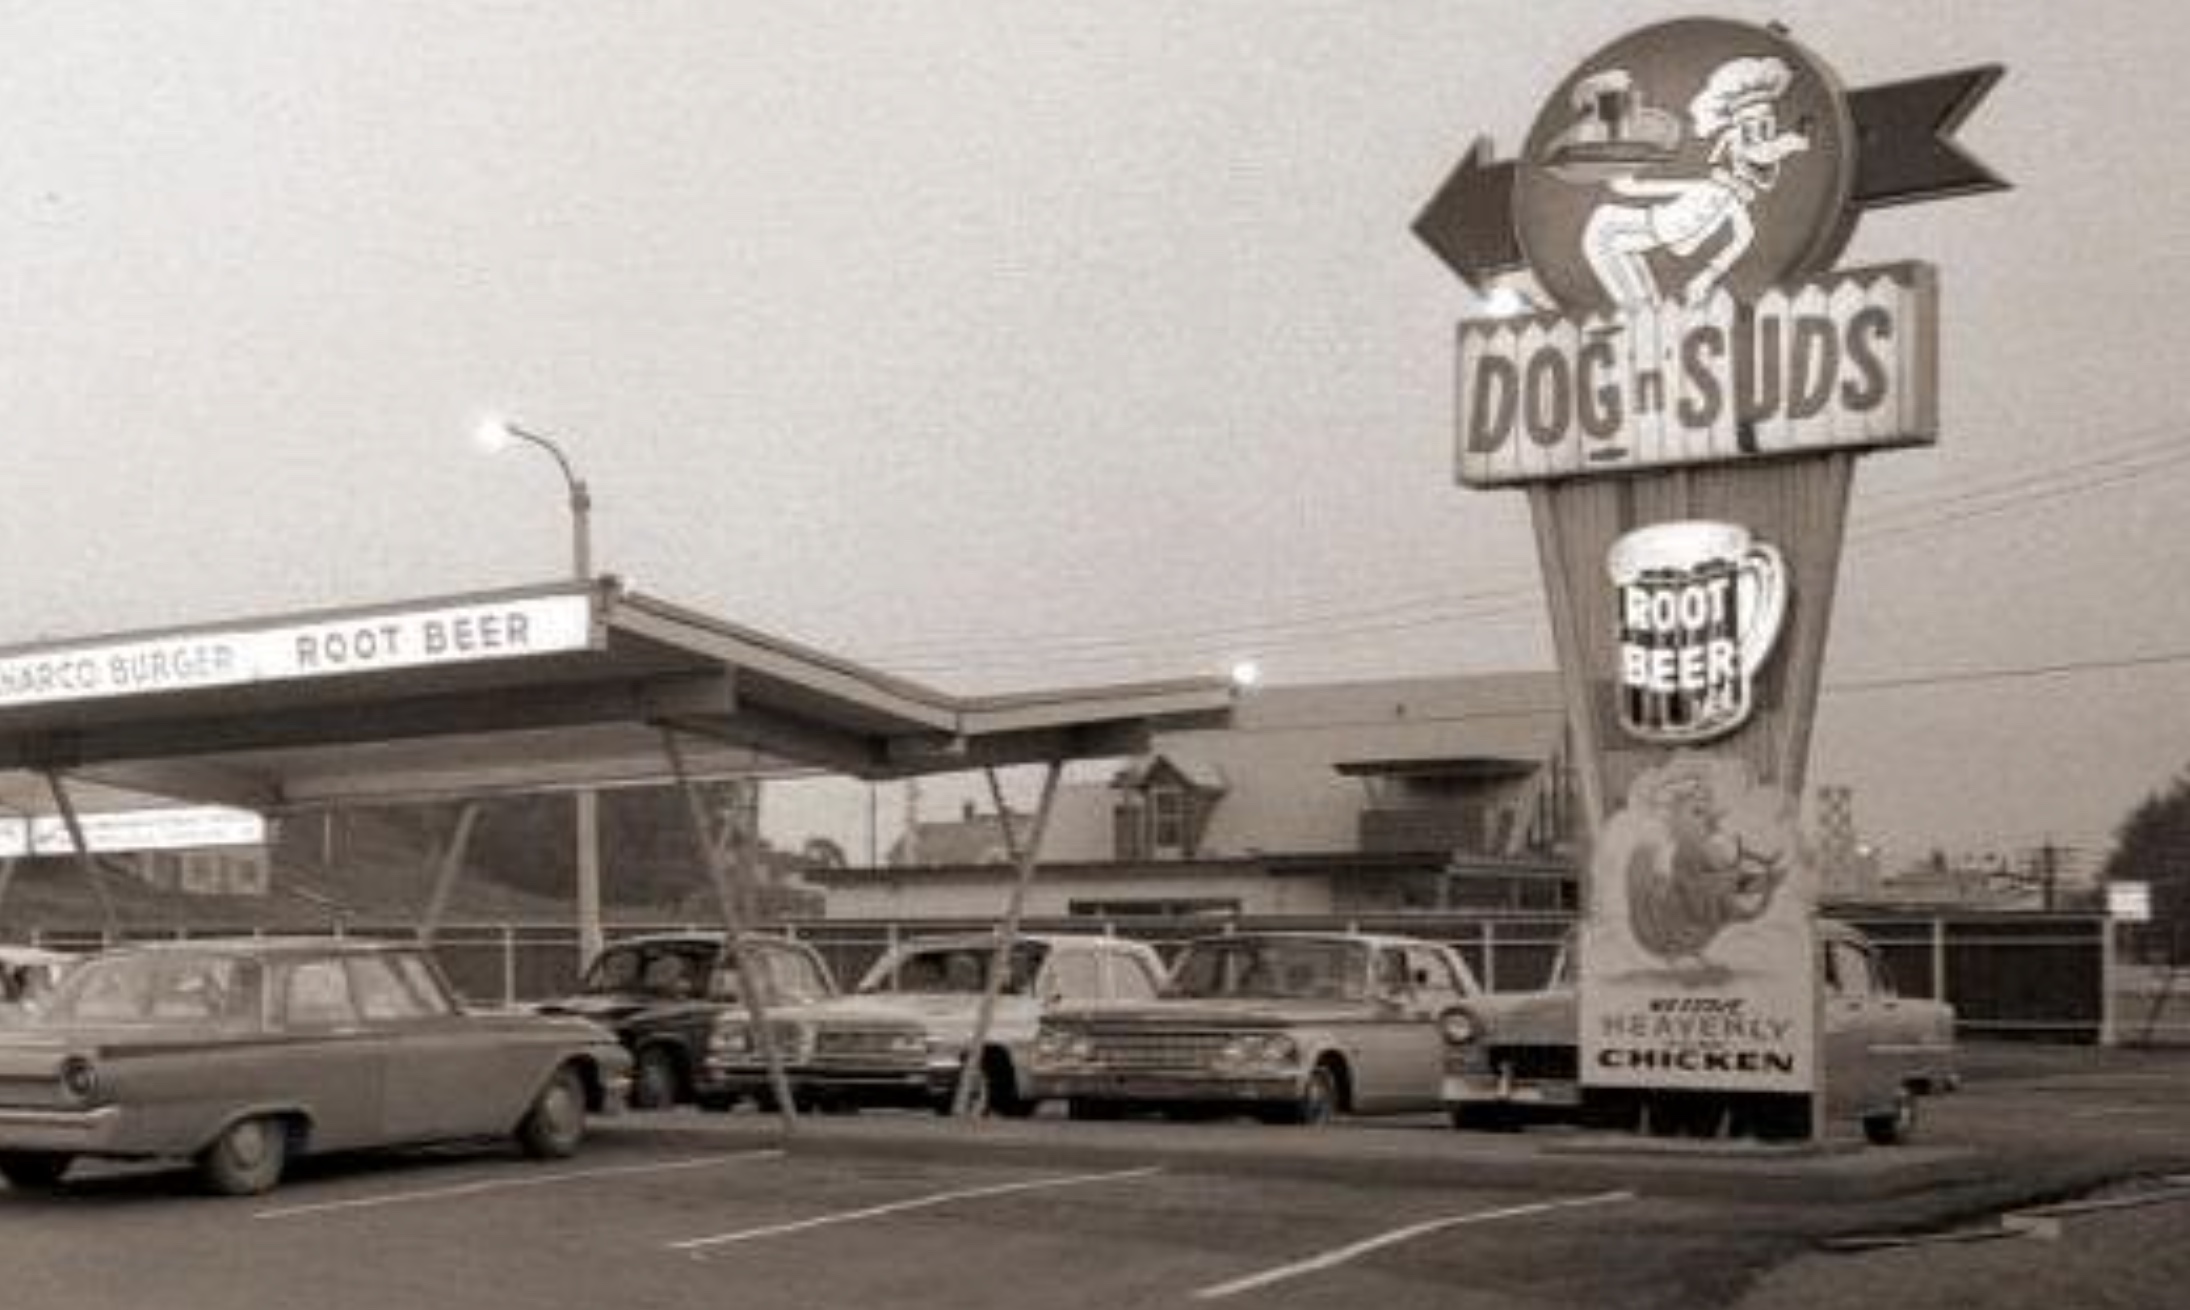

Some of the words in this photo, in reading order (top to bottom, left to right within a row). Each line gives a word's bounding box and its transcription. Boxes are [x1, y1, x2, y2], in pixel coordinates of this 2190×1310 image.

[1468, 338, 1623, 454] DOG
[1677, 304, 1893, 429] SUDS
[1626, 580, 1729, 631] ROOT
[295, 625, 399, 668] ROOT
[423, 611, 529, 655] BEER
[108, 645, 235, 686] BURGER
[1622, 638, 1736, 693] BEER
[1602, 1014, 1793, 1040] HEAVENLY
[1598, 1049, 1793, 1074] CHICKEN
